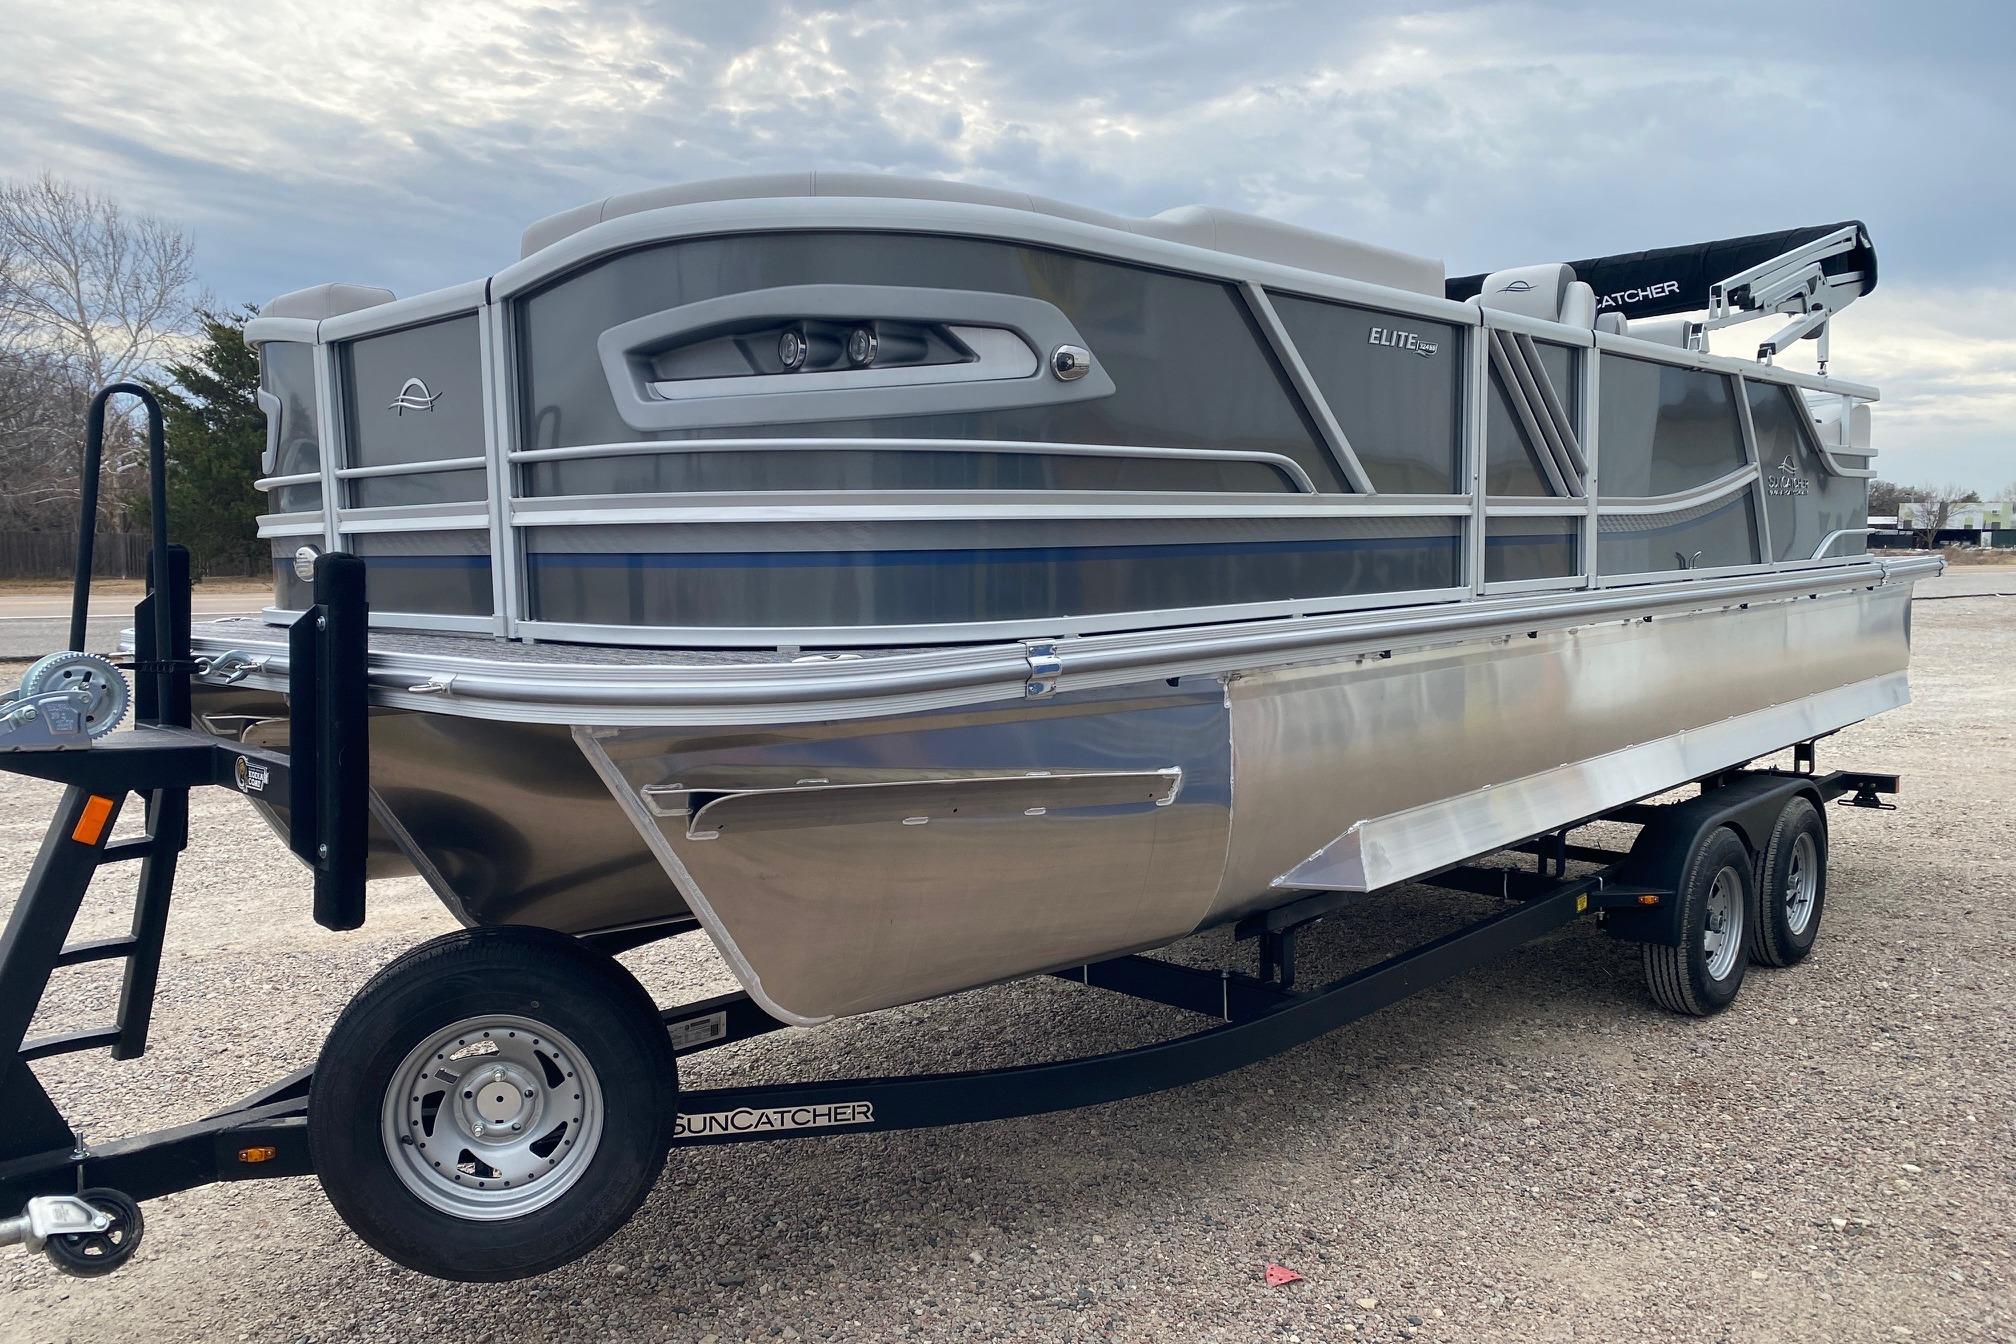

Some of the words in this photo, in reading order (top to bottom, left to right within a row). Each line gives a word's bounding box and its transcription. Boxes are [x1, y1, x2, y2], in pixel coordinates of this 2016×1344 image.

[1369, 327, 1418, 350] ELITE
[1768, 475, 1809, 488] SUCATCHER
[674, 1103, 871, 1135] SUNCATCHER
